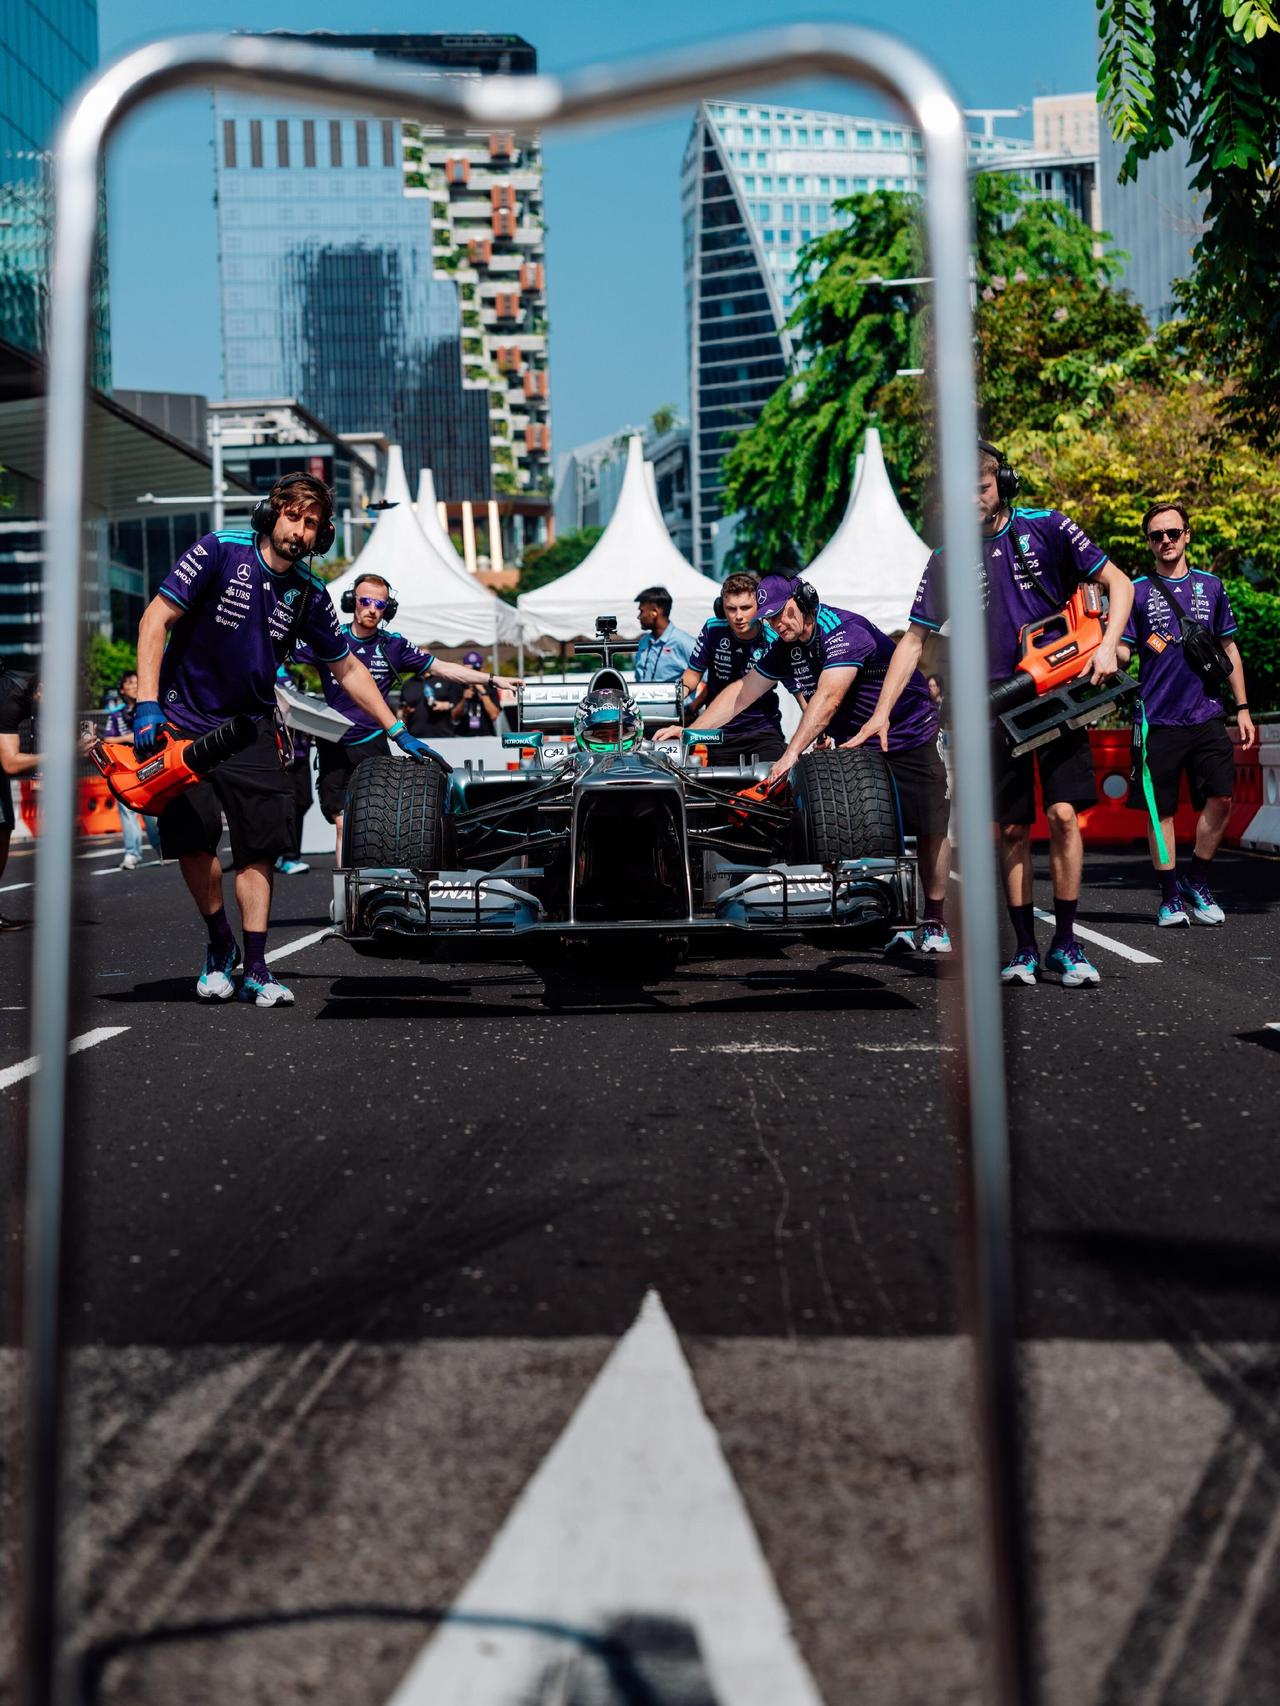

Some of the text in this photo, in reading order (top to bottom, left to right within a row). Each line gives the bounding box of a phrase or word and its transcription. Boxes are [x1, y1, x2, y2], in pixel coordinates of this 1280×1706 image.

[1013, 559, 1040, 571] INOS
[1019, 581, 1035, 591] HP
[235, 589, 251, 601] UBS
[272, 607, 294, 624] INEOS
[690, 734, 720, 742] PETRONAS
[543, 748, 565, 758] G42
